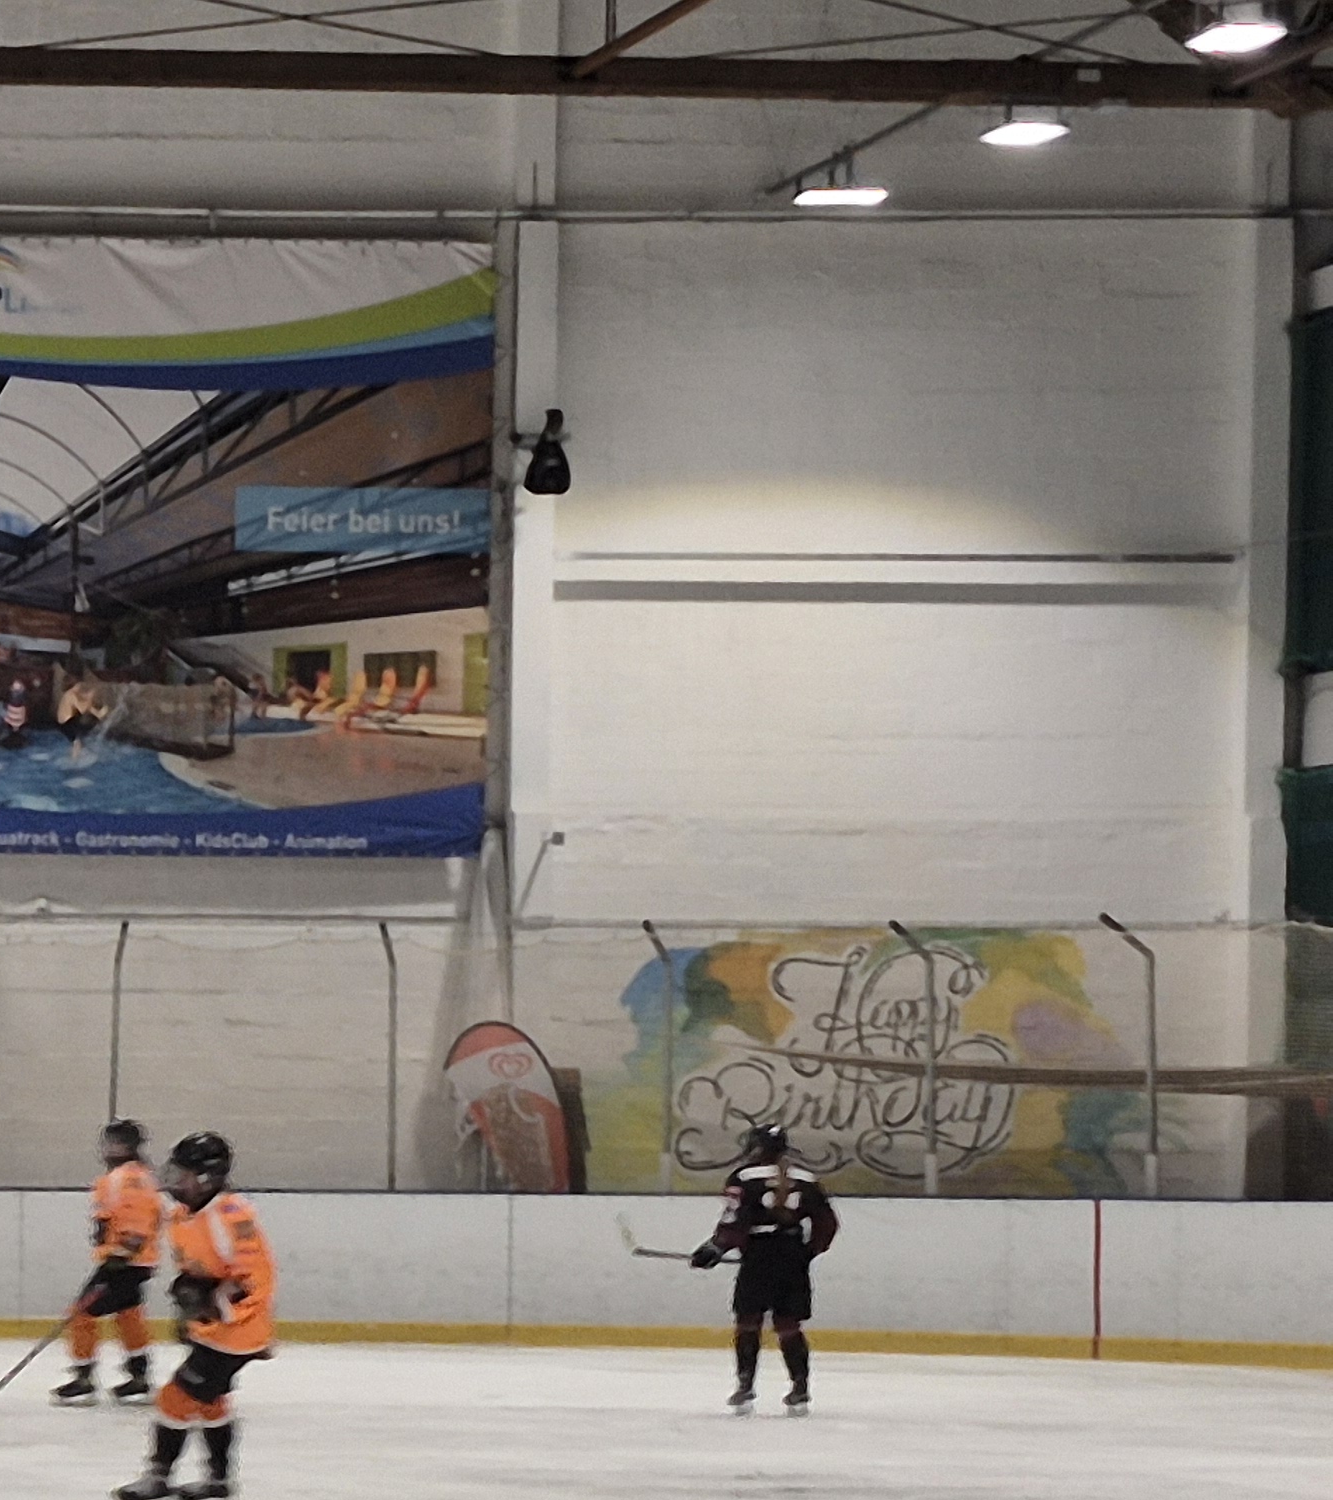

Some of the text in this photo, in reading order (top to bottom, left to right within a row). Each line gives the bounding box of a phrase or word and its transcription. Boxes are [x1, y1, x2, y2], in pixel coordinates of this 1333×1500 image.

[267, 506, 460, 533] Feier bei uns!
[284, 833, 368, 849] Animation
